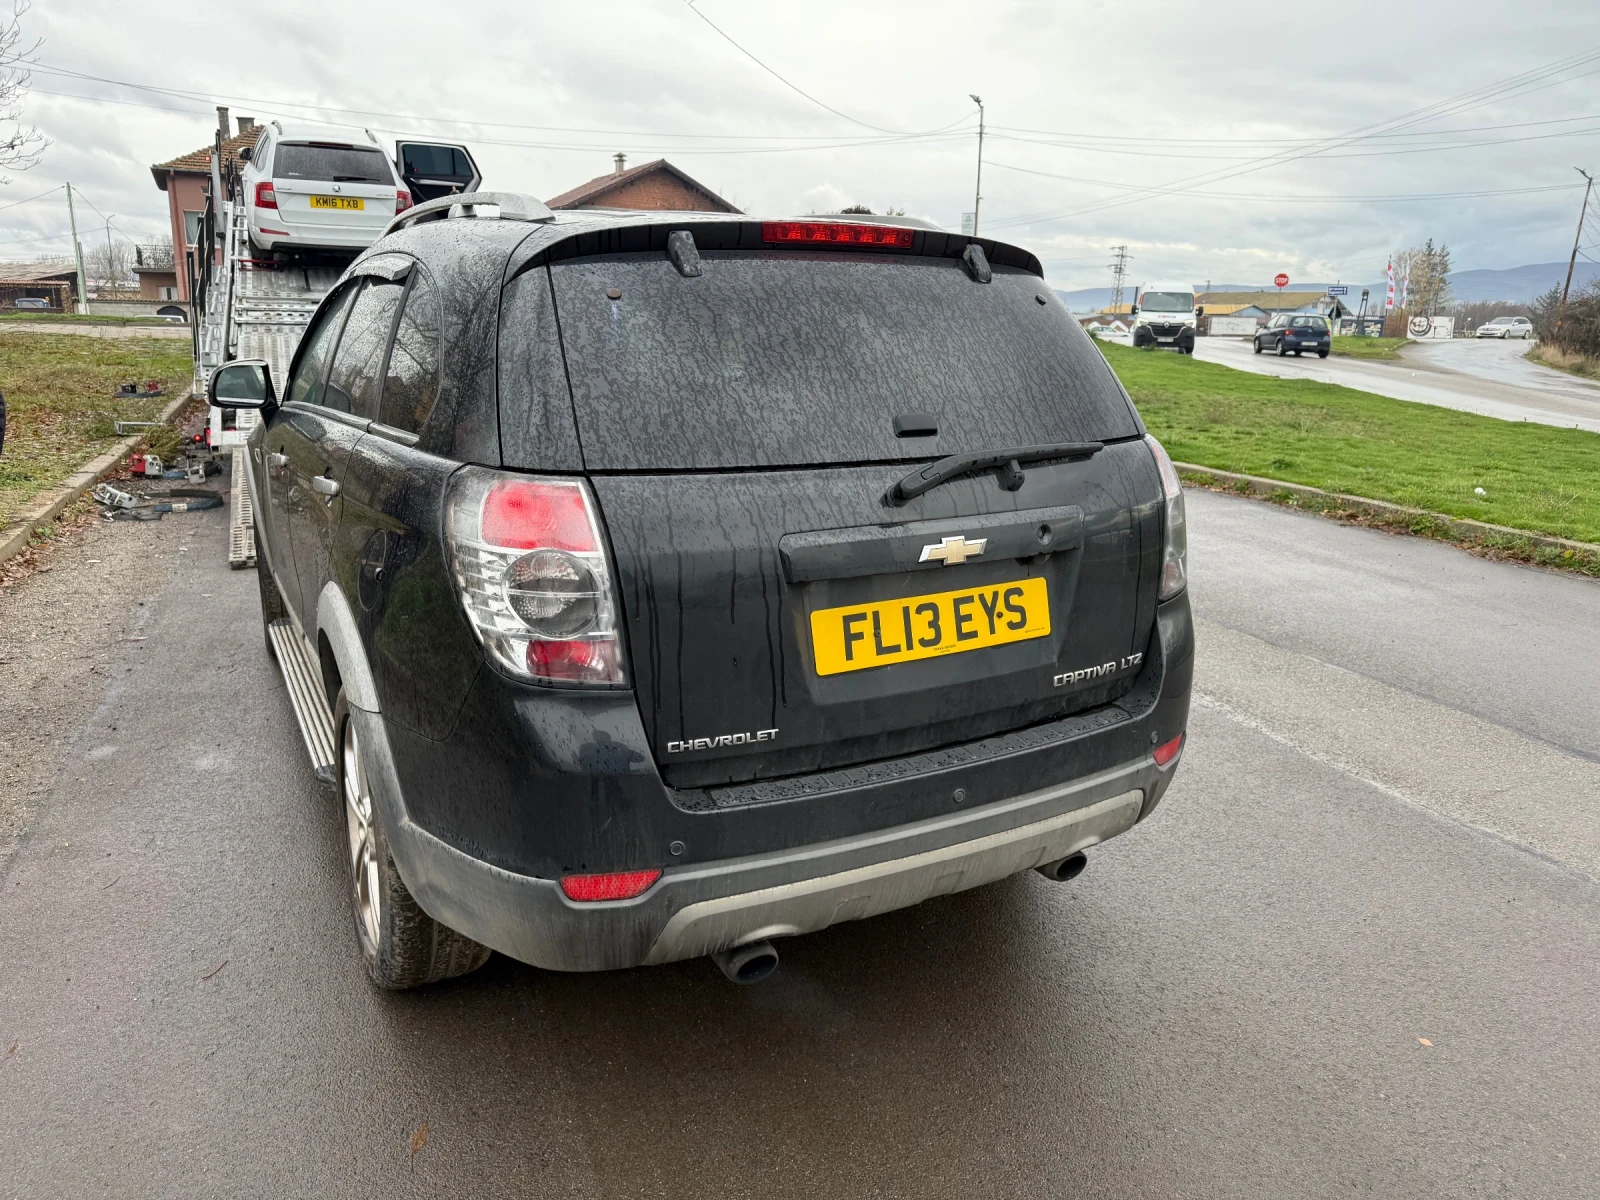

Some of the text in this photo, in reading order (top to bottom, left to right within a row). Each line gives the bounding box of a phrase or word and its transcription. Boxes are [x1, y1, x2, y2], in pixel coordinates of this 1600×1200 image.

[315, 197, 359, 209] KM16 TXB
[842, 587, 1027, 661] FL13 EYS
[1053, 652, 1143, 688] CAPTIVA LTZ
[667, 728, 779, 754] CHEVROLET
